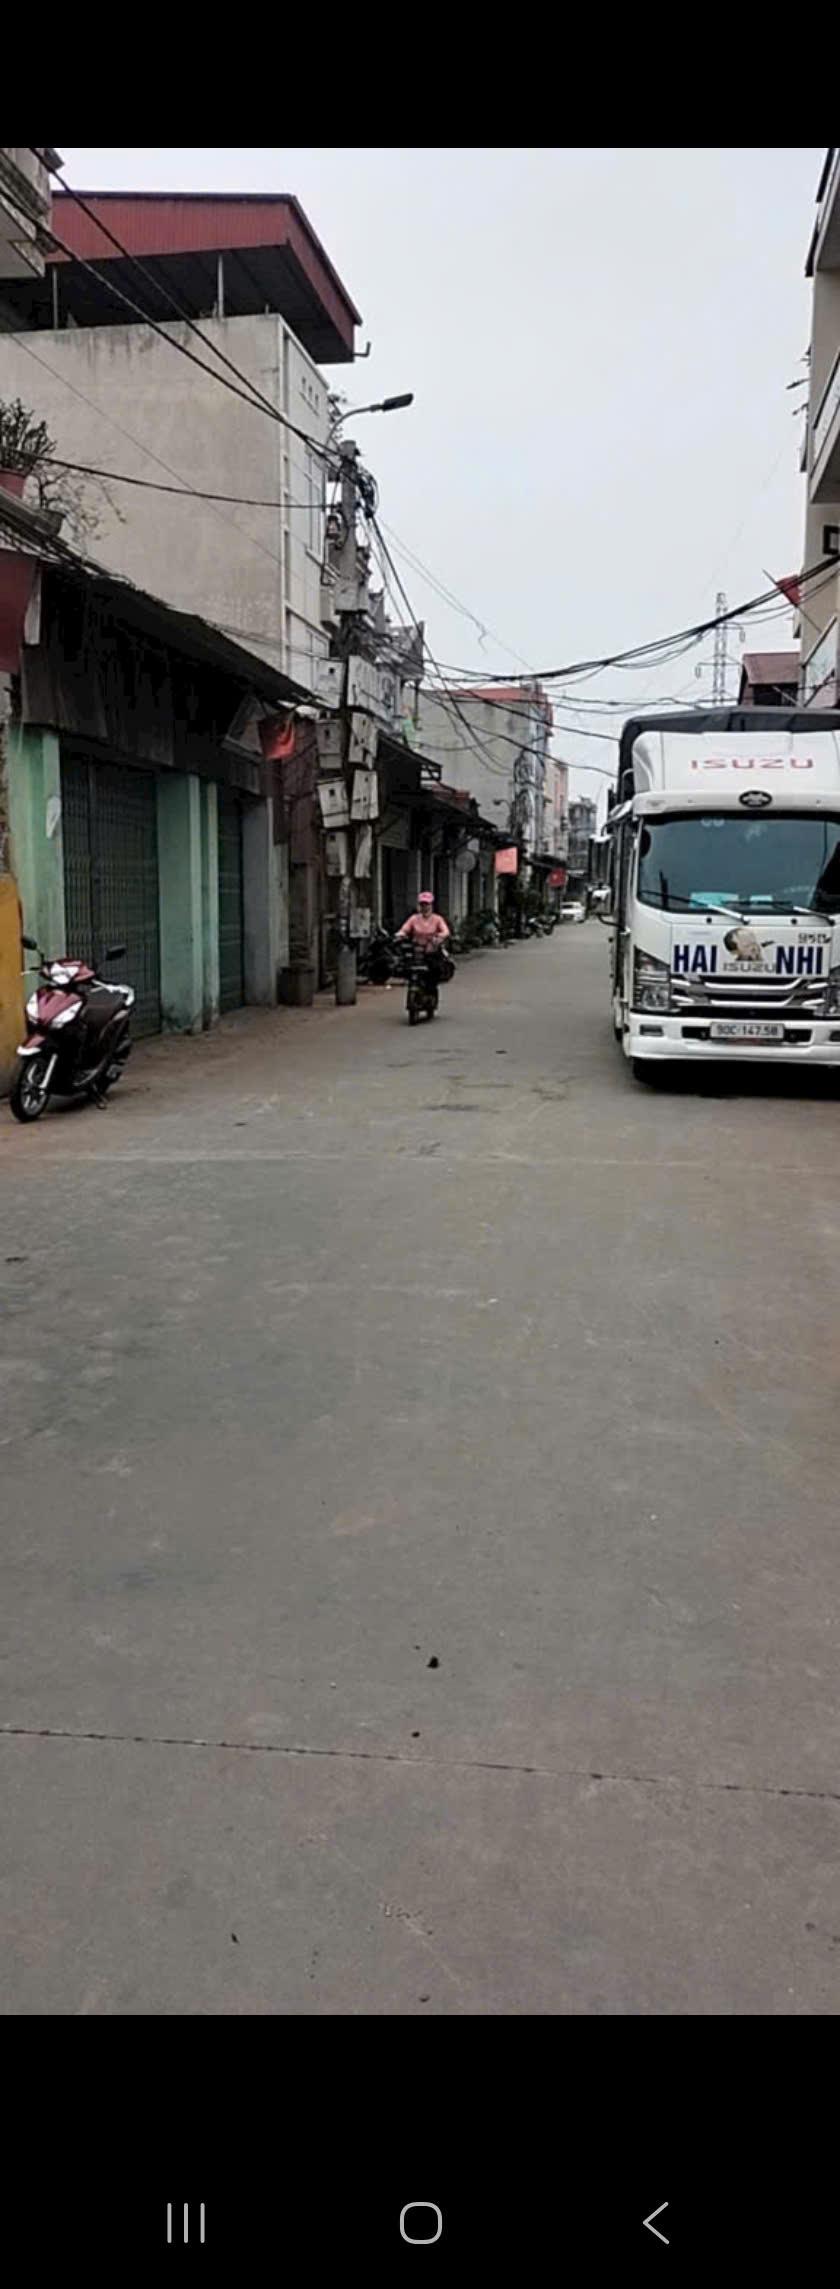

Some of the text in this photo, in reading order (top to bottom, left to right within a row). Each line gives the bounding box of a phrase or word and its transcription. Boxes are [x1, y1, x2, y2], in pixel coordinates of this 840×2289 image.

[691, 758, 814, 769] ISUZU
[673, 944, 823, 974] HAI NHI
[723, 962, 777, 972] ISUZU
